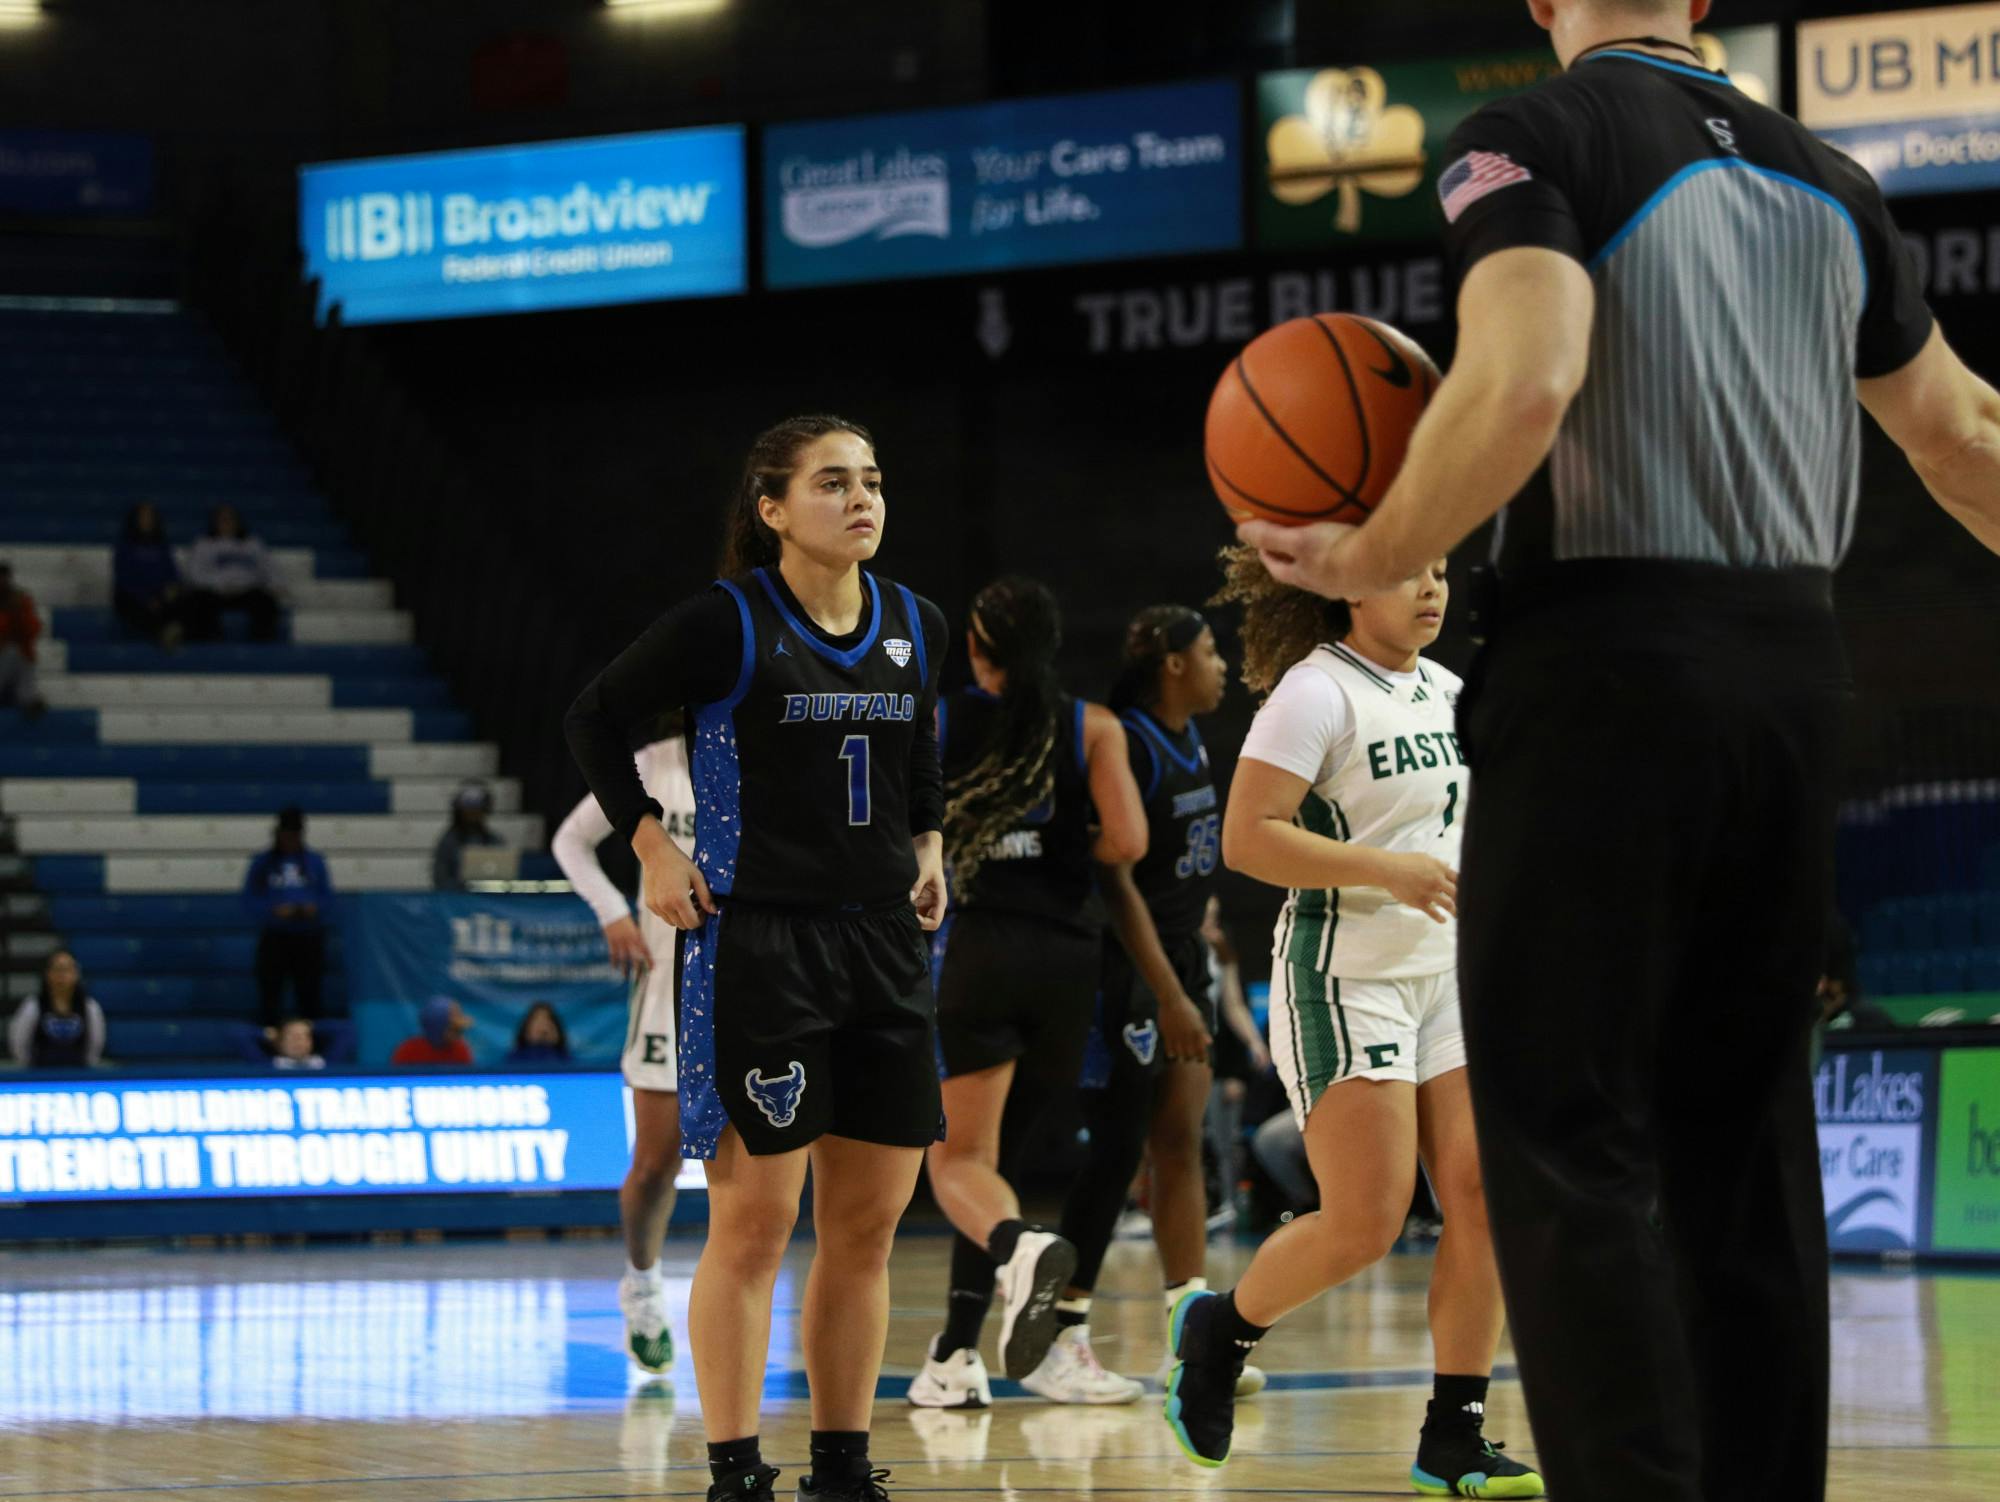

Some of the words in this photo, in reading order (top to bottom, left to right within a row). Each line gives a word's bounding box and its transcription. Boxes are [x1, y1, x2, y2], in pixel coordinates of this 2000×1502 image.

[1814, 38, 1912, 96] UB
[861, 146, 946, 182] Lakes
[972, 146, 1044, 184] Your
[1050, 139, 1131, 177] Care
[1133, 132, 1225, 169] Team
[442, 179, 714, 245] Broadview
[530, 246, 600, 278] Credit
[601, 240, 673, 271] Union
[1074, 277, 1255, 354] TRUE
[779, 693, 914, 723] BUFFALO
[838, 735, 870, 826] 1
[1175, 813, 1220, 879] 35
[643, 1034, 668, 1064] E
[121, 1089, 295, 1134] BUILDING
[295, 1087, 412, 1130] TRADE
[413, 1085, 551, 1127] UNIONS
[203, 1131, 428, 1188] THROUGH
[429, 1129, 569, 1183] UNITY
